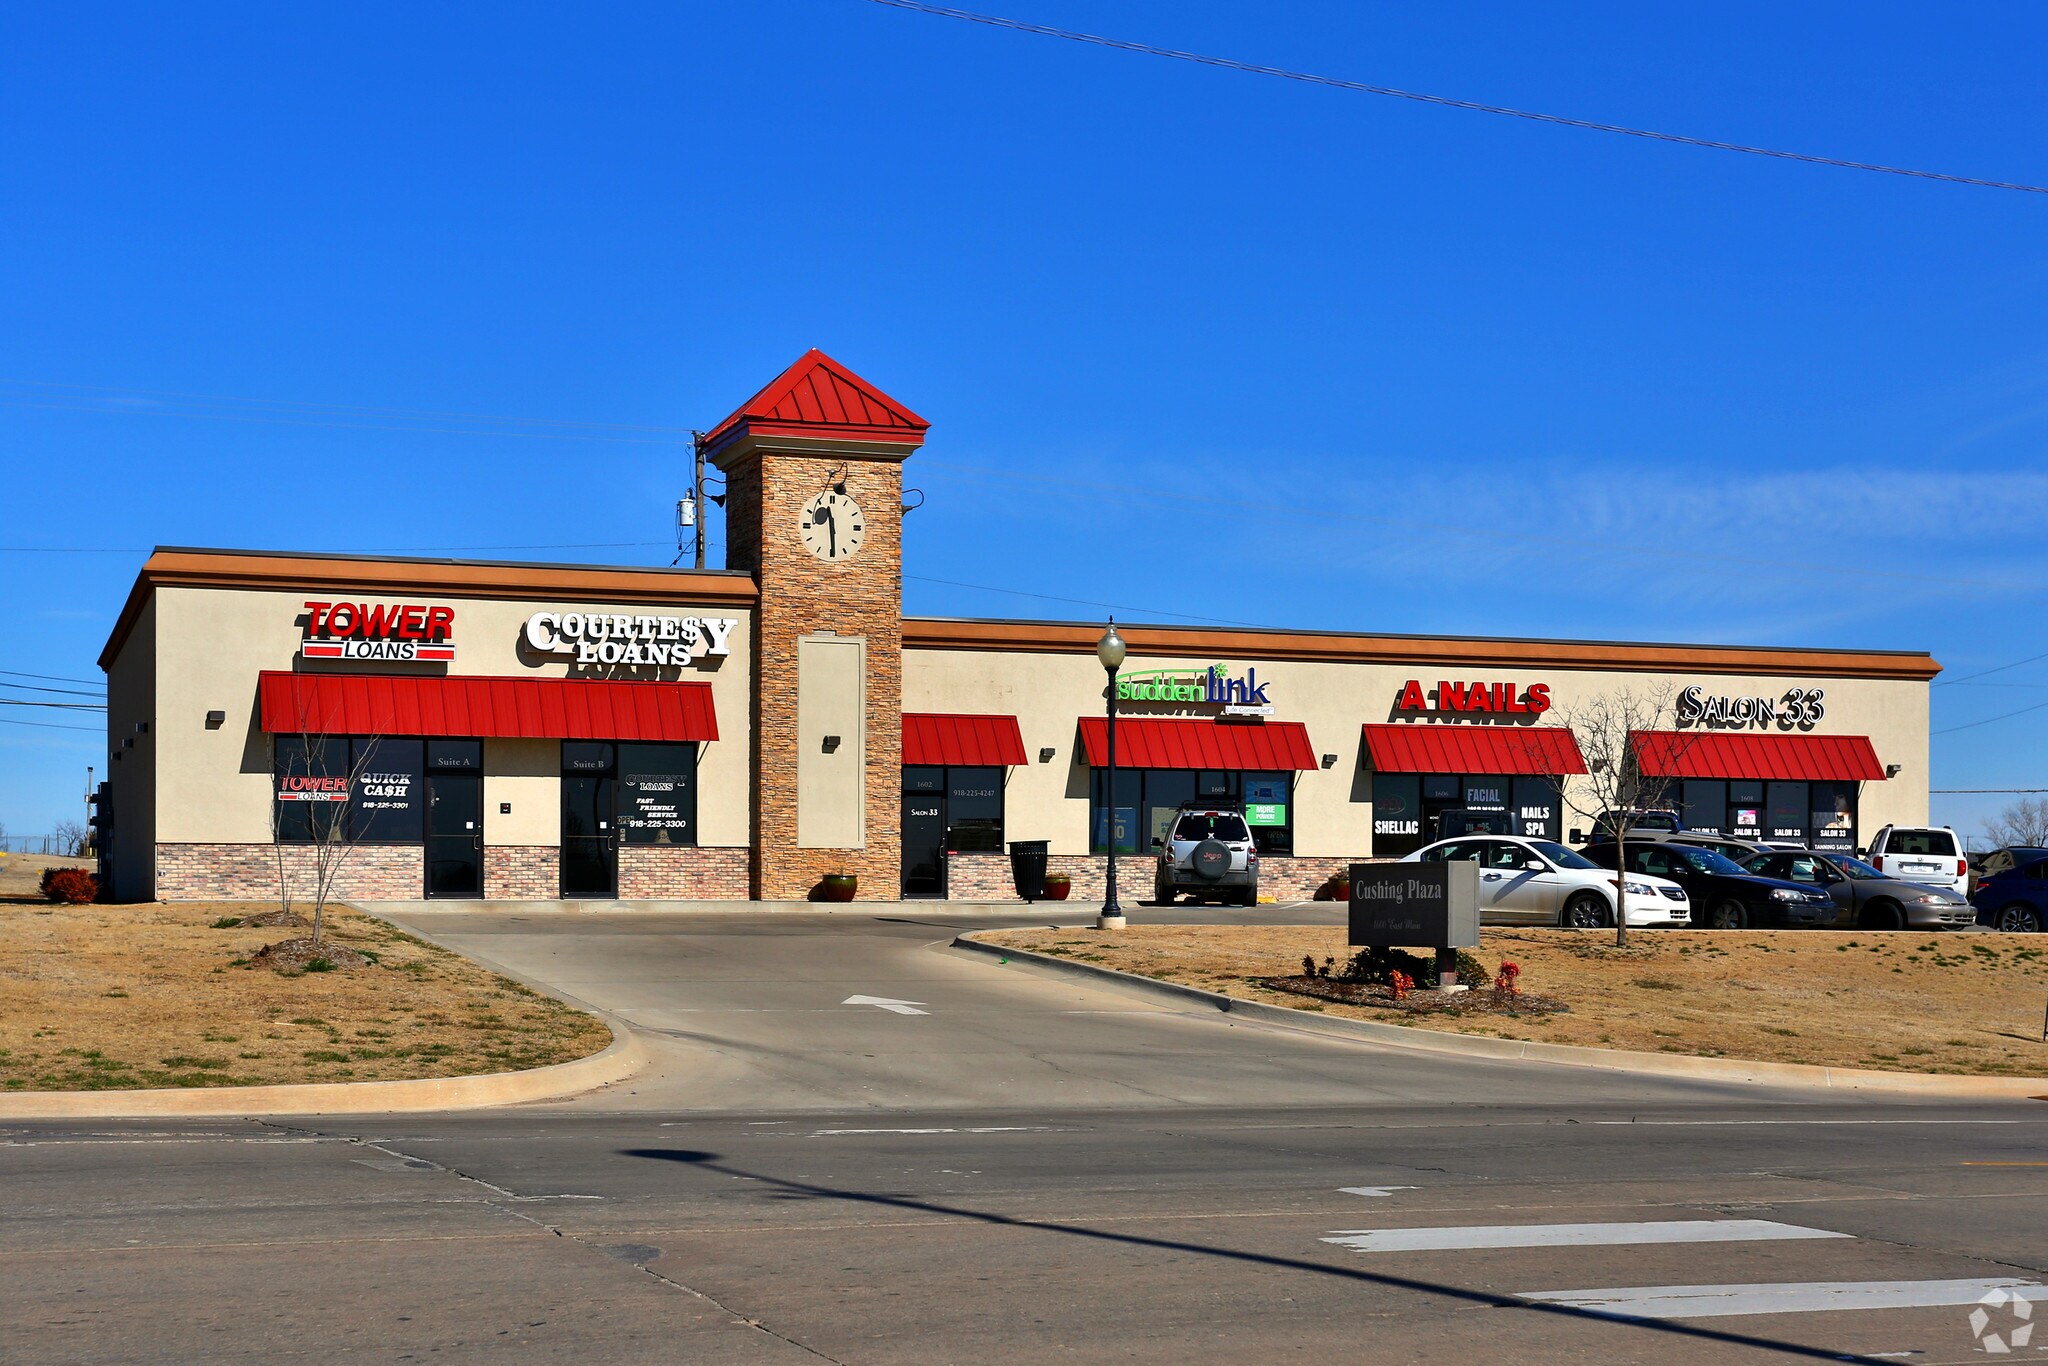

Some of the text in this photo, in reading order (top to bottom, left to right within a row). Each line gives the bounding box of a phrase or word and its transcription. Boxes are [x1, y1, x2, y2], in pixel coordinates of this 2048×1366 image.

[304, 602, 455, 639] TOWER
[344, 642, 415, 659] LOANS
[576, 641, 693, 666] LOANS
[1117, 664, 1271, 704] suddenlink
[1399, 680, 1551, 713] A NAILS
[1684, 684, 1825, 724] SALON 33
[438, 758, 471, 766] Suite A
[573, 760, 604, 768] Suite B
[281, 775, 348, 791] TOWER
[360, 772, 412, 785] QUICK
[640, 782, 673, 791] LOANS
[297, 792, 330, 800] LOANS
[953, 789, 995, 797] 918-225-4247
[1467, 789, 1500, 802] FACIAL
[362, 801, 409, 809] 918-225-3301
[1256, 805, 1275, 813] MORE
[1521, 807, 1550, 819] NAILS
[629, 820, 686, 828] 918-225-3300
[1375, 820, 1419, 834] SHELLAC
[1525, 822, 1545, 835] SPA
[1733, 828, 1761, 836] SALON 33
[1774, 828, 1793, 836] SALON
[1820, 829, 1838, 837] SALON
[1203, 852, 1222, 860] Jeep
[1356, 879, 1442, 904] Cushing Plaza
[1387, 918, 1403, 930] East
[1404, 919, 1421, 929] Main
